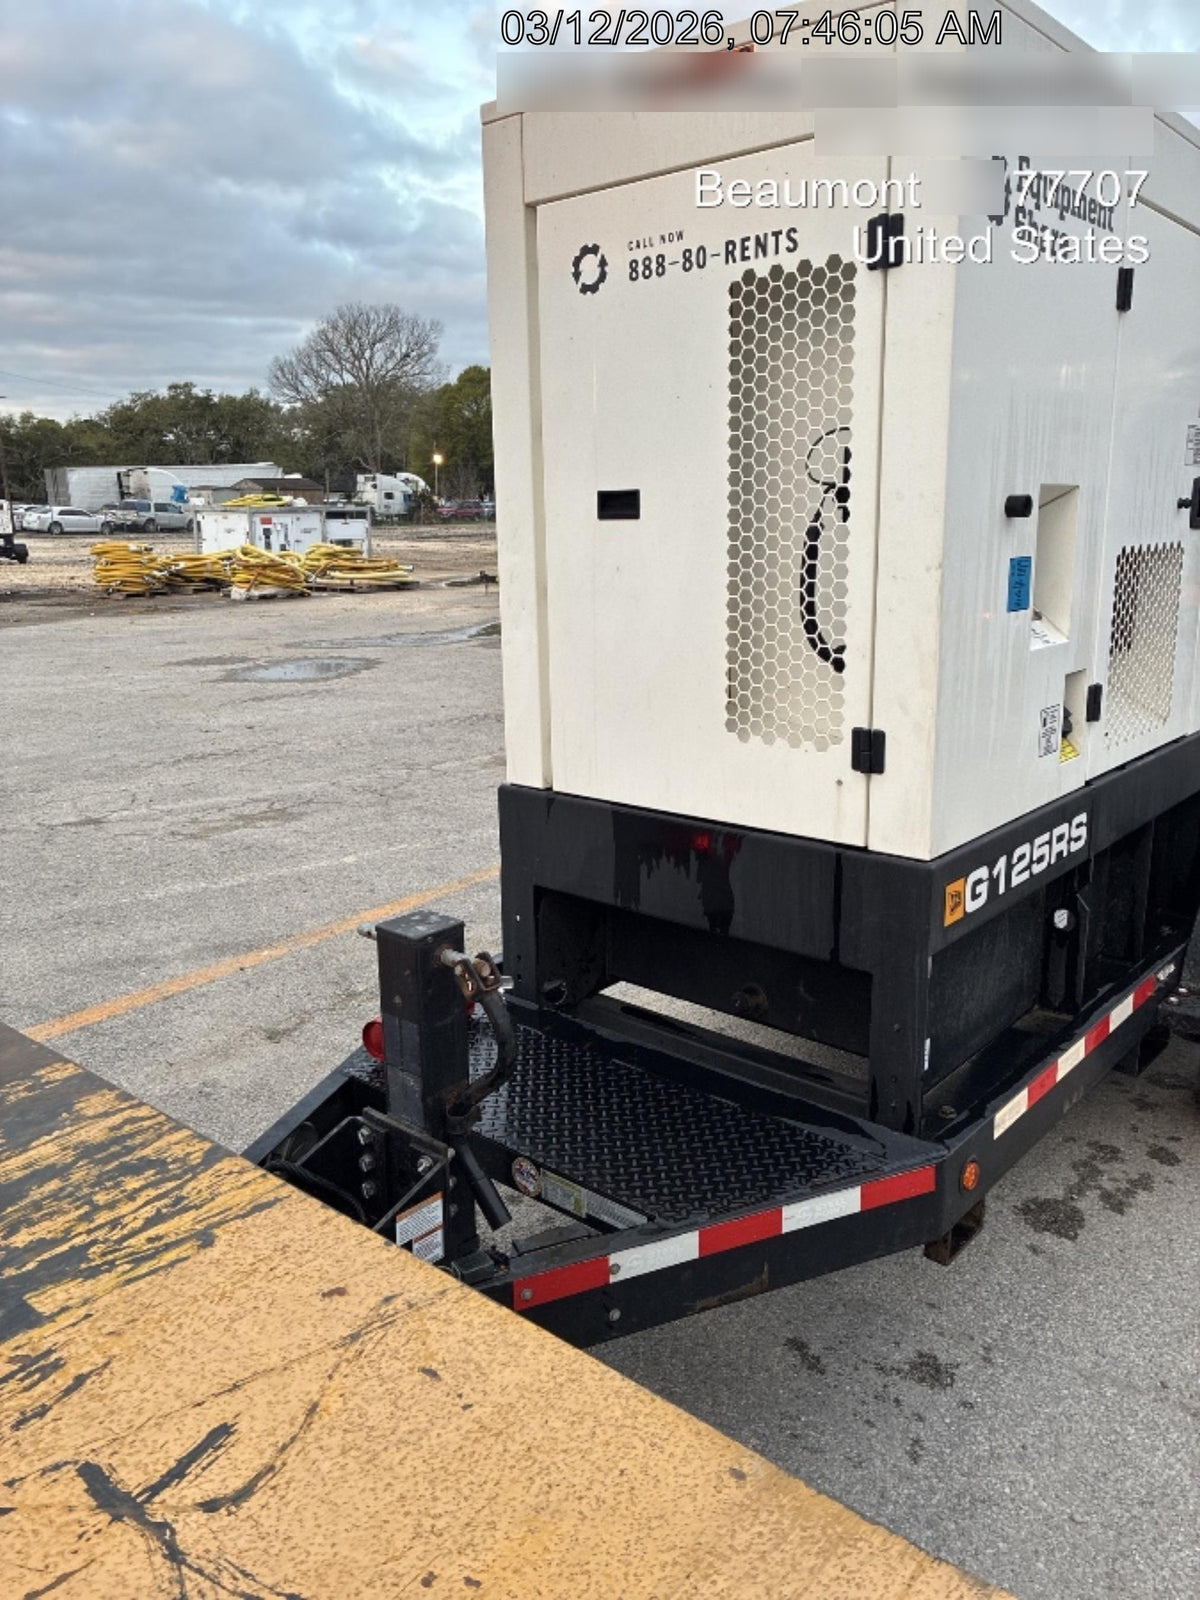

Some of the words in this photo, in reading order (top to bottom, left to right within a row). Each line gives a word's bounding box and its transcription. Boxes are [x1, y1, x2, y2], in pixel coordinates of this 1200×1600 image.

[627, 236, 654, 252] CALL
[659, 230, 685, 246] NOW
[628, 227, 799, 282] 888-80-RENTS
[965, 812, 1088, 913] G125RS
